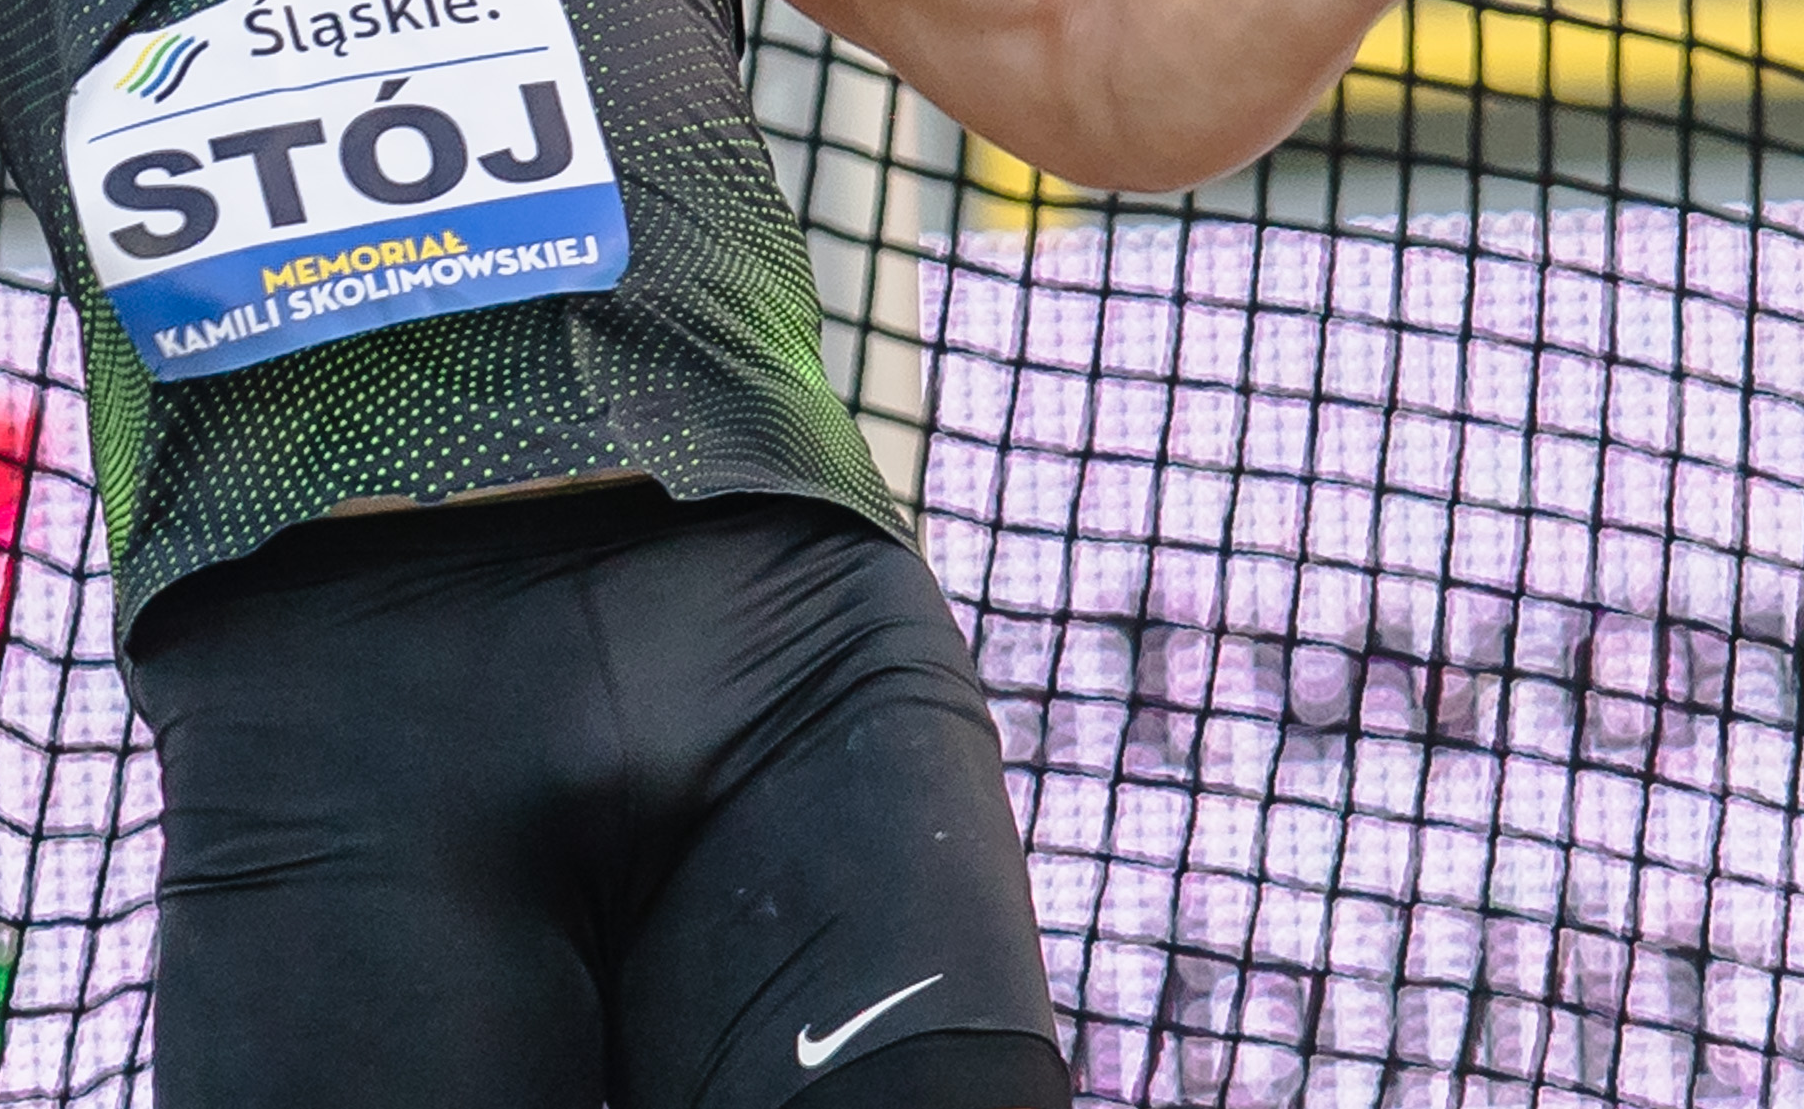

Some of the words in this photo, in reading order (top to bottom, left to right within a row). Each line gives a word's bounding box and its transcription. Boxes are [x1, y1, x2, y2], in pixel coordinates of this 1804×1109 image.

[102, 77, 574, 260] STÓJ
[153, 308, 281, 360] KAMILI
[288, 234, 600, 322] SKOLIMOWSKIEJ
[262, 229, 469, 294] MEMORIAŁ
